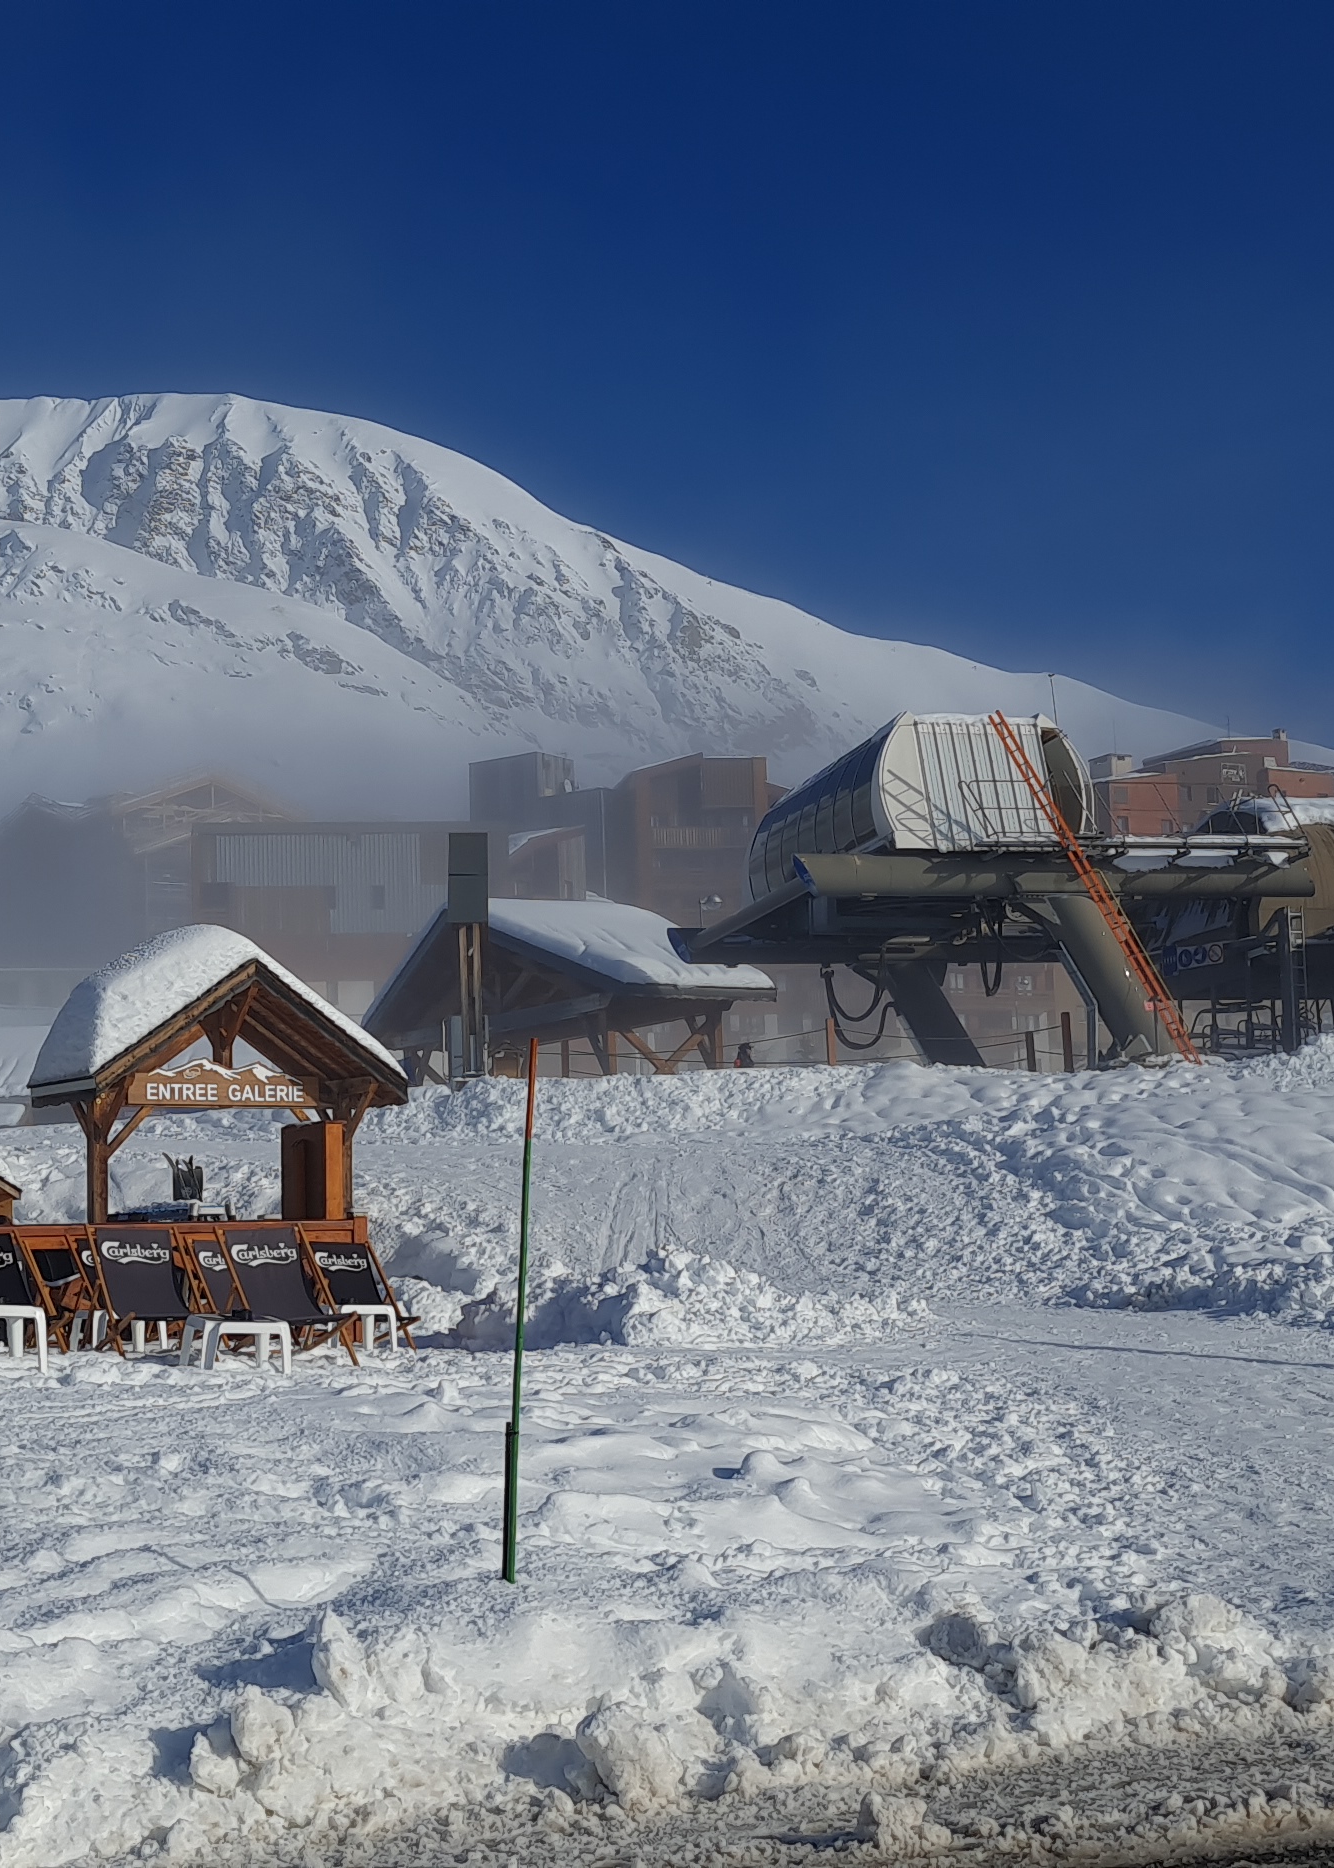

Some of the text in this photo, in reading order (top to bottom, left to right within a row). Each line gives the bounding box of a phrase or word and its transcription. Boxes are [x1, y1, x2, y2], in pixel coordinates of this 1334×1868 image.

[146, 1083, 305, 1102] ENTREE GALERIE
[101, 1241, 170, 1265] Carlsberg
[230, 1242, 298, 1266] Carlsberg
[315, 1251, 367, 1271] Carlsberg
